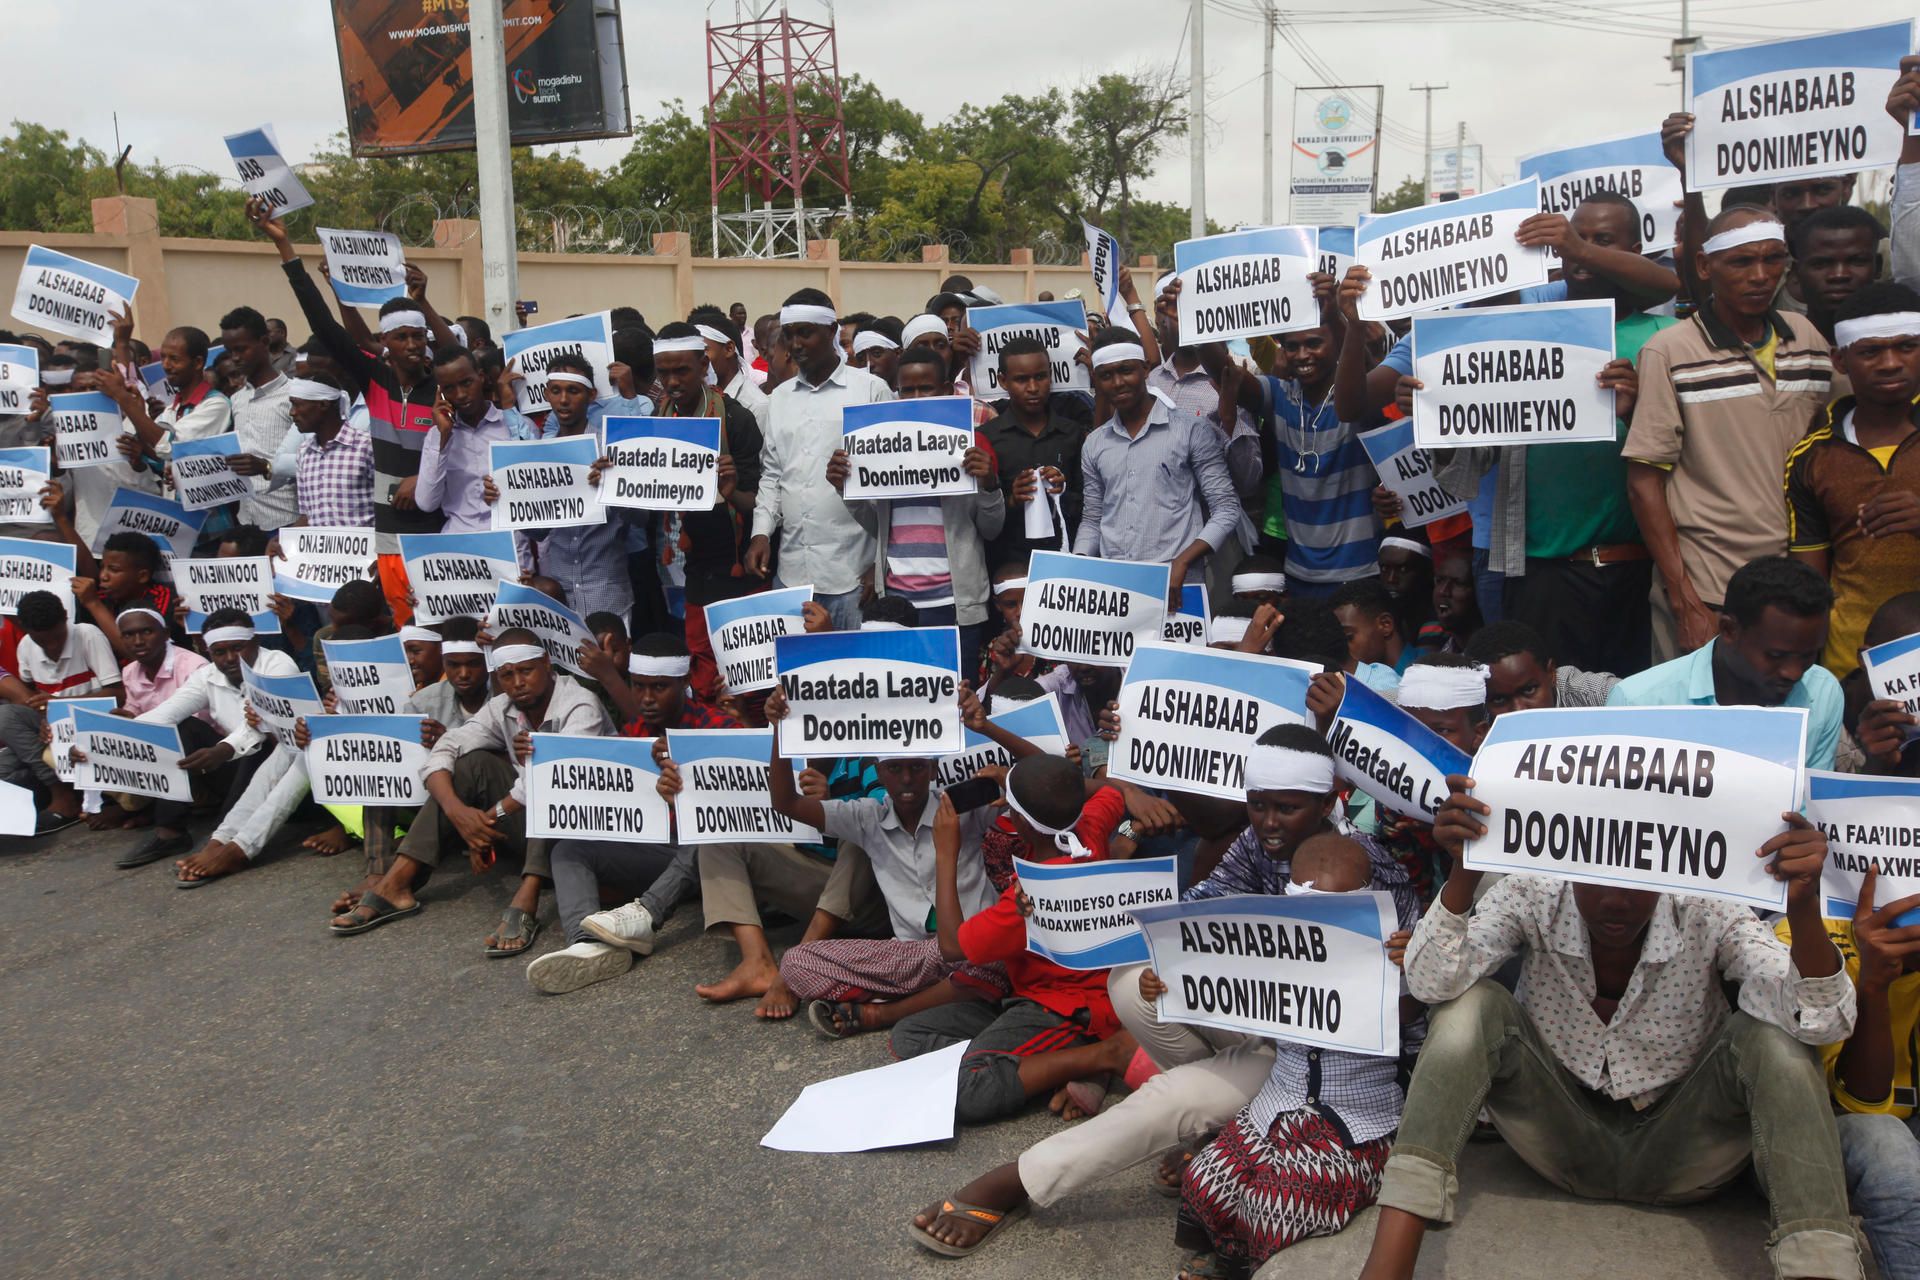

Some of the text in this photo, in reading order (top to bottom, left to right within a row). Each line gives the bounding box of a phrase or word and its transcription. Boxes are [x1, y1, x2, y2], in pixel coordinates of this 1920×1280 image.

[538, 74, 582, 88] mogadishu
[1721, 71, 1855, 123] ALSHABAAB
[1717, 125, 1867, 176] DOONIMEYNO
[330, 236, 389, 256] DOONIMEYNO
[1381, 214, 1494, 261] ALSHABAAB
[37, 269, 107, 305] ALSHABAAB
[341, 265, 393, 284] ALSHABAAB
[1196, 257, 1281, 294] ALSHABAAB
[1380, 253, 1508, 309] DOONIMEYNO
[28, 294, 105, 331] DOONIMEYNO
[1196, 296, 1291, 334] DOONIMEYNO
[1442, 347, 1564, 385] ALSHABAAB
[1439, 398, 1576, 436] DOONIMEYNO
[844, 430, 968, 456] Maatada Laaye
[176, 456, 228, 478] ALSHABAAB
[607, 446, 714, 473] Maatada Laaye
[184, 478, 248, 504] DOONIMEYNO
[507, 466, 574, 490] ALSHABAAB
[616, 477, 704, 505] Doonimeyno
[858, 465, 960, 489] Doonimeyno
[118, 509, 180, 537] ALSHABAAB
[510, 497, 584, 522] DOONIMEYNO
[299, 534, 368, 556] DOONIMEYNO
[190, 563, 259, 584] DOONIMEYNO
[296, 563, 363, 584] ALSHABAAB
[422, 559, 492, 582] ALSHABAAB
[200, 593, 259, 612] ALSHABAAB
[1039, 583, 1130, 617] ALSHABAAB
[498, 607, 571, 636] ALSHABAAB
[1031, 622, 1134, 657] DOONIMEYNO
[725, 656, 775, 687] DOONIME
[781, 671, 954, 705] Maatada Laaye
[1884, 678, 1907, 695] KA
[1138, 686, 1260, 735] ALSHABAAB
[803, 713, 942, 746] Doonimeyno
[90, 734, 157, 763] ALSHABAAB
[326, 739, 403, 763] ALSHABAAB
[1330, 719, 1414, 802] Maatada
[94, 763, 170, 793] DOONIMEYNO
[552, 764, 634, 792] ALSHABAAB
[1514, 743, 1716, 799] ALSHABAAB
[325, 775, 412, 798] DOONIMEYNO
[549, 803, 643, 833] DOONIMEYNO
[1503, 807, 1727, 880] DOONIMEYNO
[1039, 894, 1114, 913] FAA'IIDEYSO
[1118, 887, 1173, 907] CAFISKA
[1032, 913, 1135, 933] MADAXWEYNAHA
[1180, 921, 1327, 963] ALSHABAAB
[1182, 974, 1341, 1033] DOONIMEYNO
